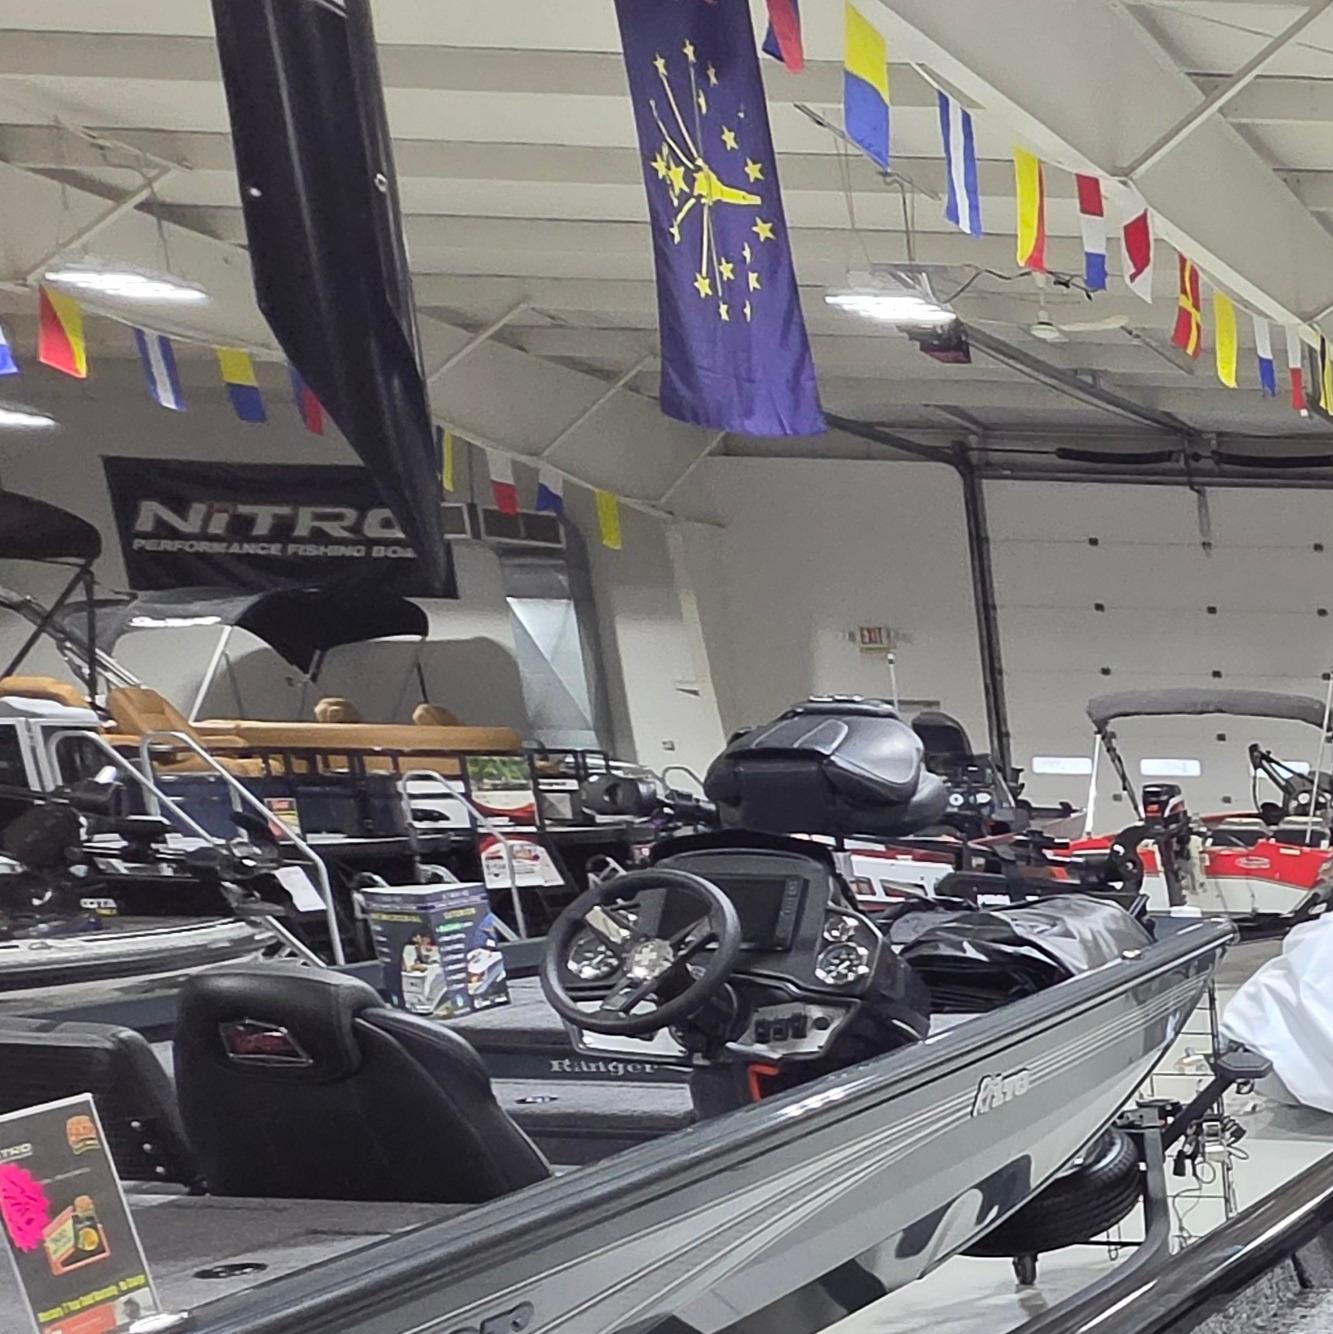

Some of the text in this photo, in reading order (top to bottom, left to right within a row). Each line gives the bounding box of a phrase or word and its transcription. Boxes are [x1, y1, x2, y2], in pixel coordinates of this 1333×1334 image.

[133, 538, 418, 559] PERFORMANCE FISHING BOA
[550, 1059, 658, 1076] Ranger
